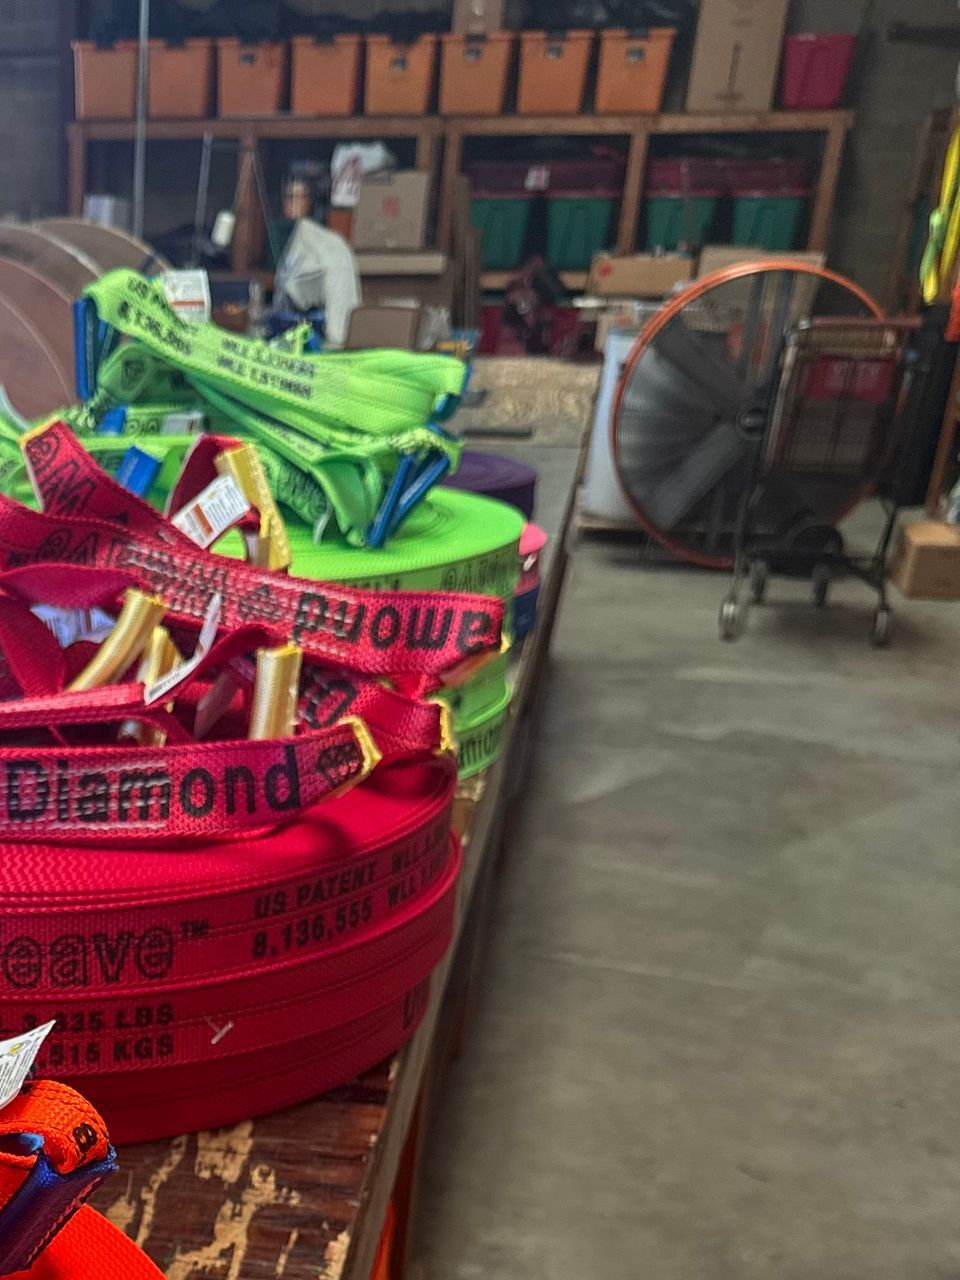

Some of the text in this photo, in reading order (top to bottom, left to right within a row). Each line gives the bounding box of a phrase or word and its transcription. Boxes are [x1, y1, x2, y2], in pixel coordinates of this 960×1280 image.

[292, 592, 491, 655] amond
[6, 745, 300, 823] Diamond
[253, 890, 287, 921] US
[295, 860, 378, 908] PATENT
[251, 897, 373, 958] 8,136,555
[22, 1010, 104, 1033] 3335
[116, 1002, 175, 1030] LBS
[40, 1034, 175, 1069] ,515 KGS
